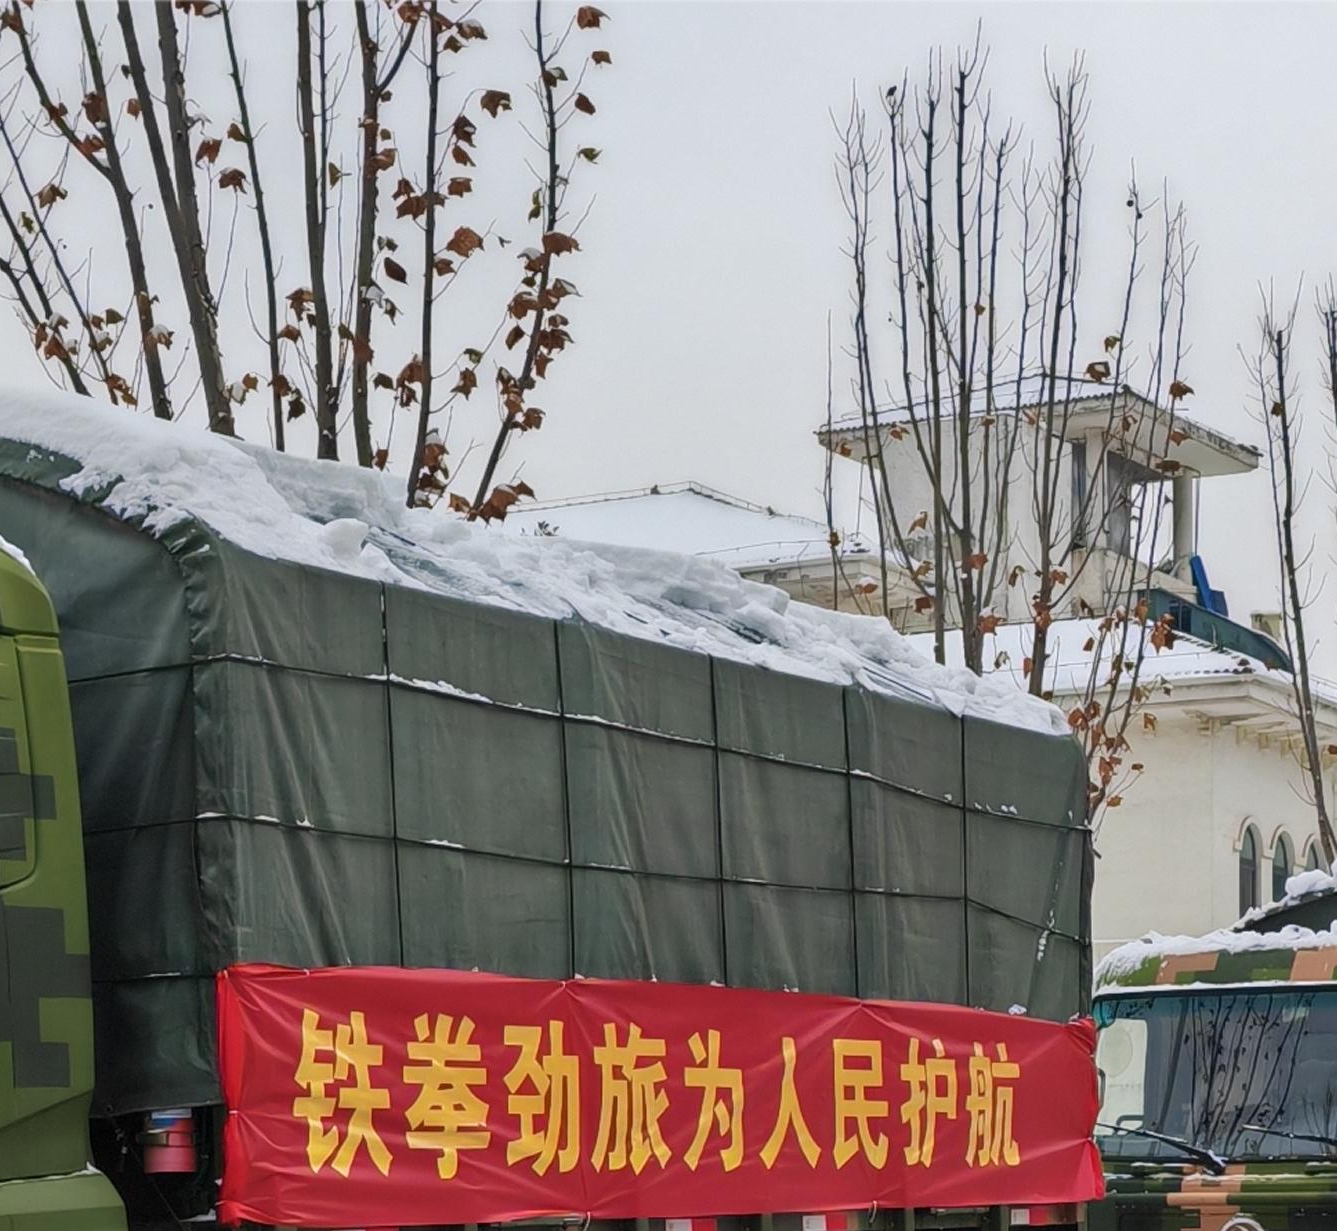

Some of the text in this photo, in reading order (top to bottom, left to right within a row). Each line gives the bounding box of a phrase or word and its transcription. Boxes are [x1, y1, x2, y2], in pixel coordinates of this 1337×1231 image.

[293, 1008, 1021, 1179] 铁拳劲旅为人民护航
